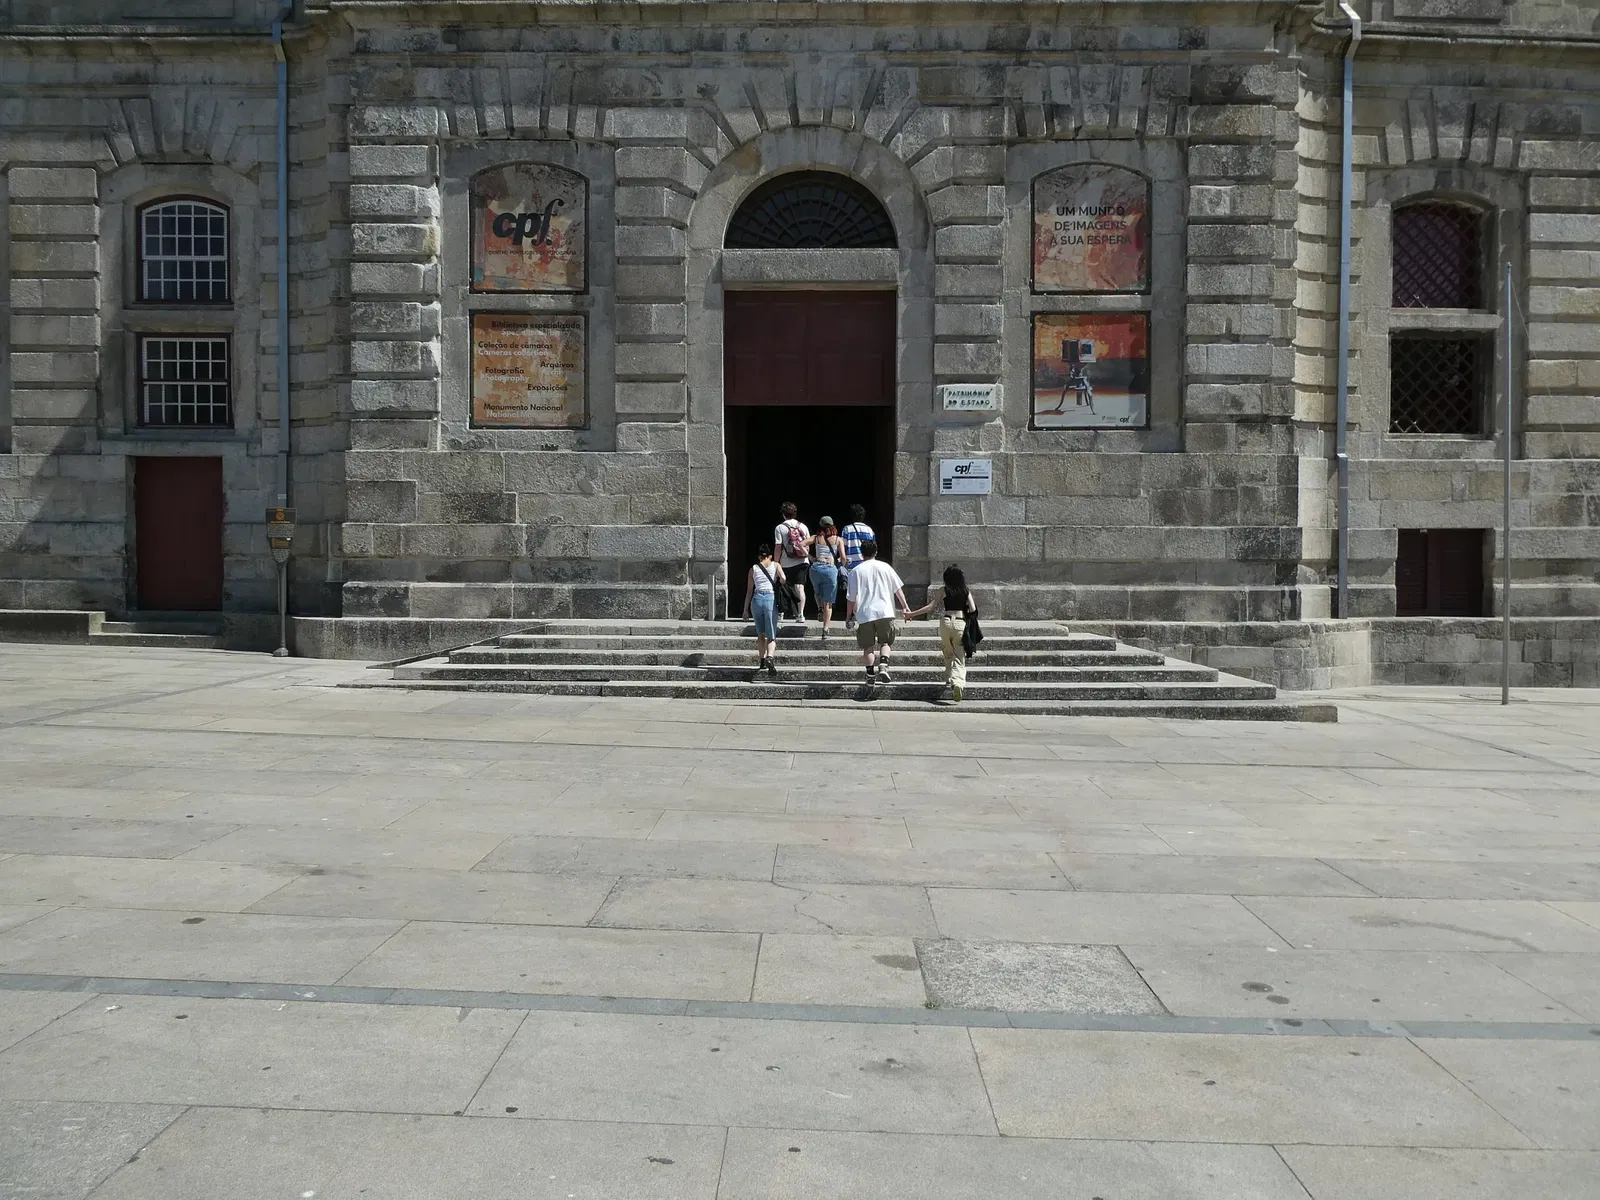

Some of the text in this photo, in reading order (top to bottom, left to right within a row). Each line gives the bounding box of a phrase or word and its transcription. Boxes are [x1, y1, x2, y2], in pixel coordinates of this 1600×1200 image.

[1056, 206, 1125, 216] UM MUNDO
[1054, 221, 1127, 231] DE IMAGENS
[1060, 235, 1084, 245] SUA
[1087, 235, 1132, 245] ESPERA
[491, 321, 581, 330] Biblioteca especializada
[478, 340, 507, 349] Coleção
[509, 341, 519, 349] de
[540, 361, 575, 369] Arquivos
[485, 367, 524, 376] Fotografia
[480, 374, 530, 383] Photography
[527, 384, 568, 392] Exposições
[483, 403, 563, 411] Monumento Nacional
